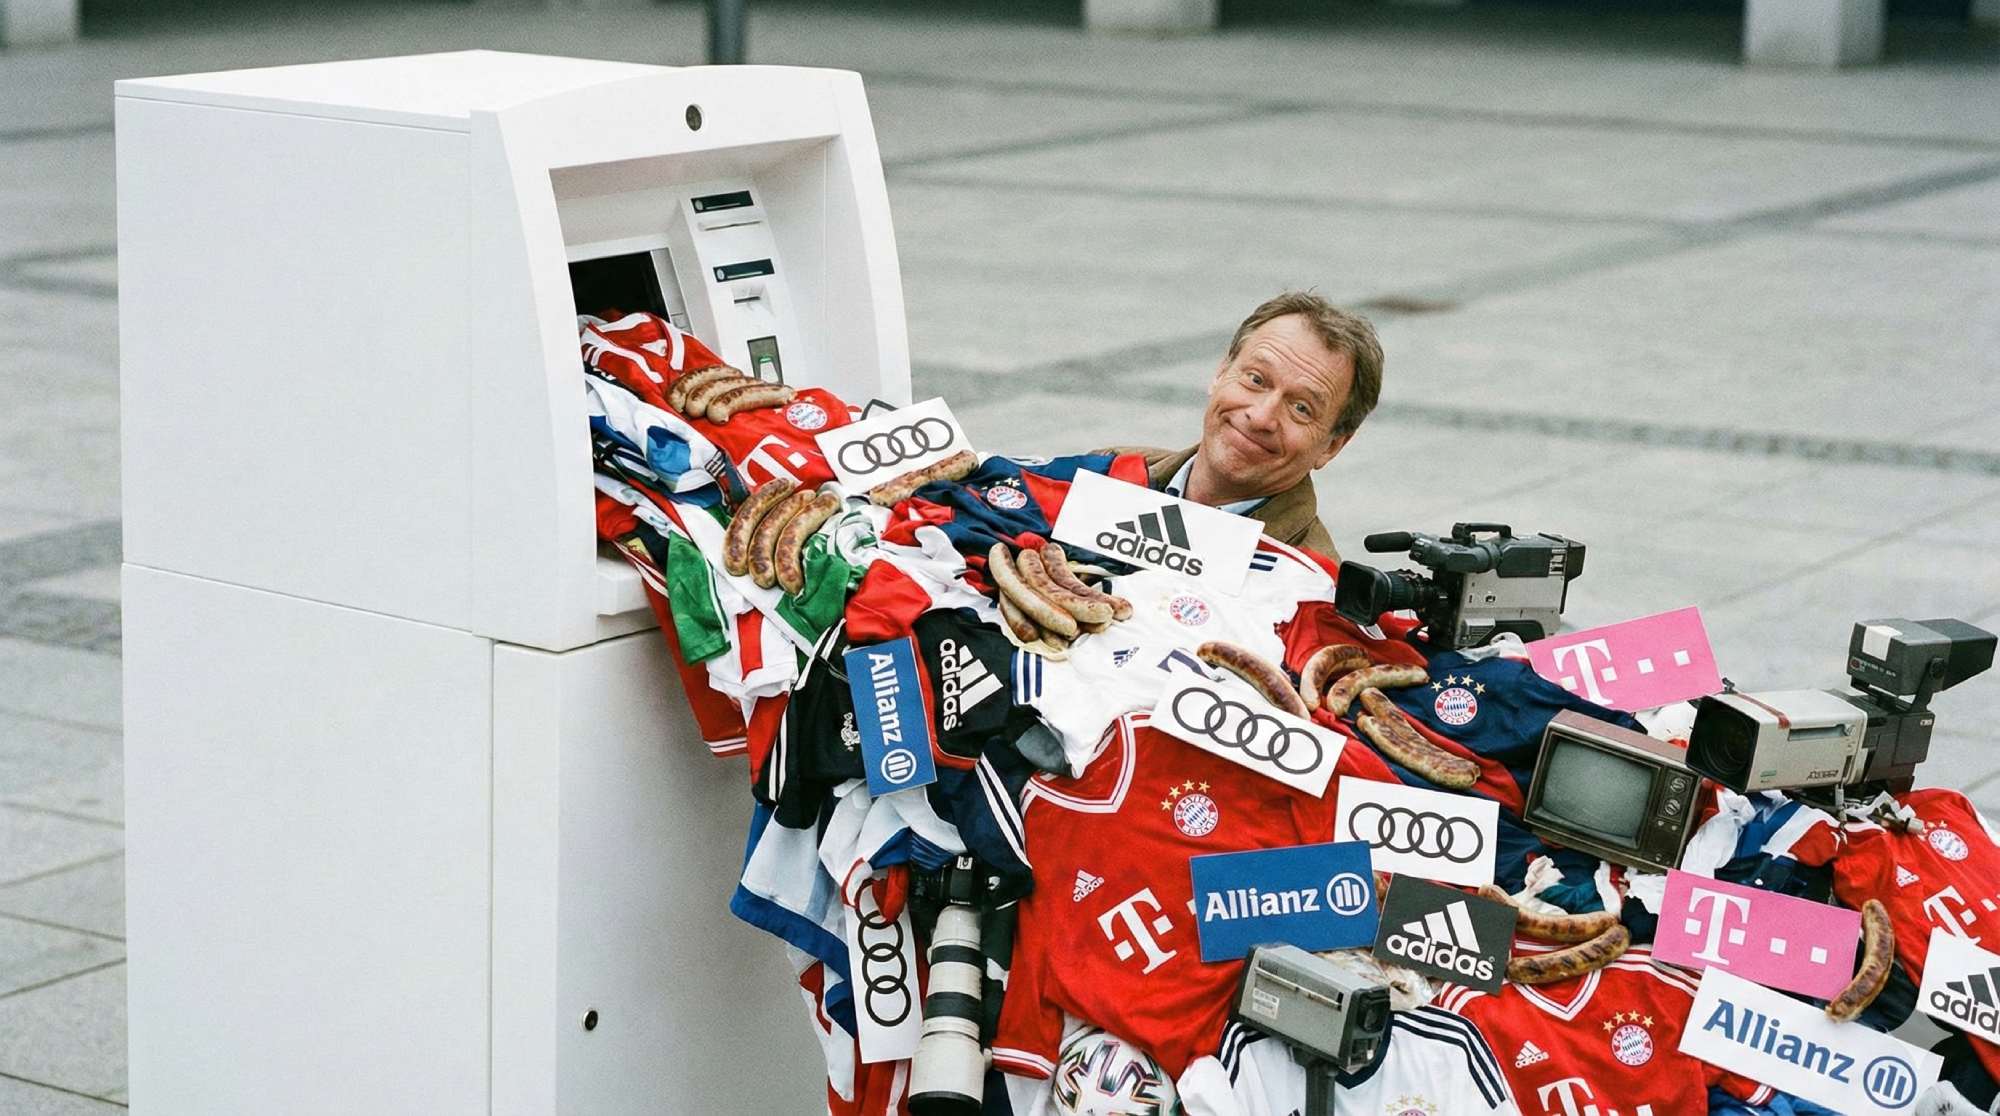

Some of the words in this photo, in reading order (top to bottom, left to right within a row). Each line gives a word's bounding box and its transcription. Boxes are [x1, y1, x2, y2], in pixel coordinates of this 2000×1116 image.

[1096, 532, 1203, 576] adidas
[868, 653, 903, 746] Allianz
[939, 638, 962, 731] adidas
[1097, 887, 1177, 975] T
[1204, 887, 1321, 922] Allianz
[1688, 887, 1752, 966] T
[1386, 934, 1494, 981] adidas
[1702, 998, 1855, 1085] Allianz
[1930, 991, 2000, 1035] adid
